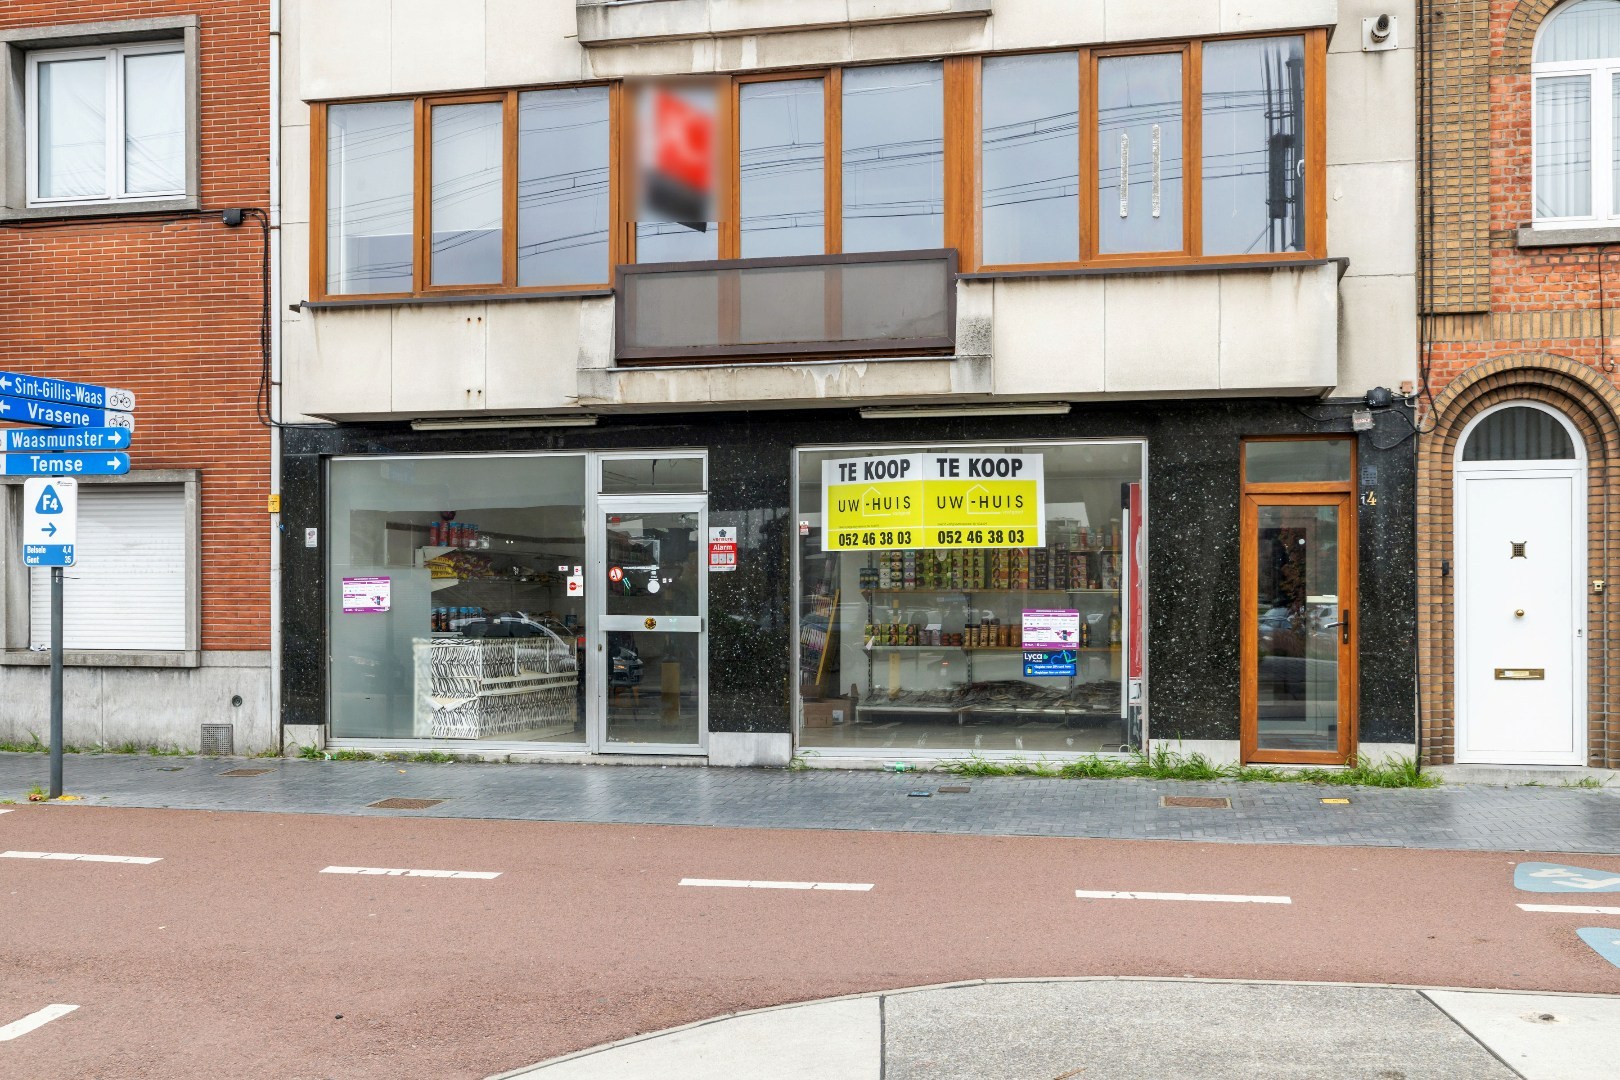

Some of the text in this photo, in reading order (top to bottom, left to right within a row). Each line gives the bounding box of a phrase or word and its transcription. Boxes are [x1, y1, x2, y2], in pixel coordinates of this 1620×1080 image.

[15, 377, 103, 405] Sint-Gillis-Waas
[28, 402, 90, 426] Vrasene
[12, 432, 104, 448] Waasmunster
[30, 456, 83, 472] Temse
[839, 459, 911, 482] TE KOOP
[936, 458, 1023, 478] TE KOOP
[42, 495, 59, 511] F4
[839, 531, 912, 546] 052 46 38 03
[938, 529, 1025, 544] 052 46 38 03
[64, 556, 72, 564] 35
[1024, 653, 1043, 661] Lyca
